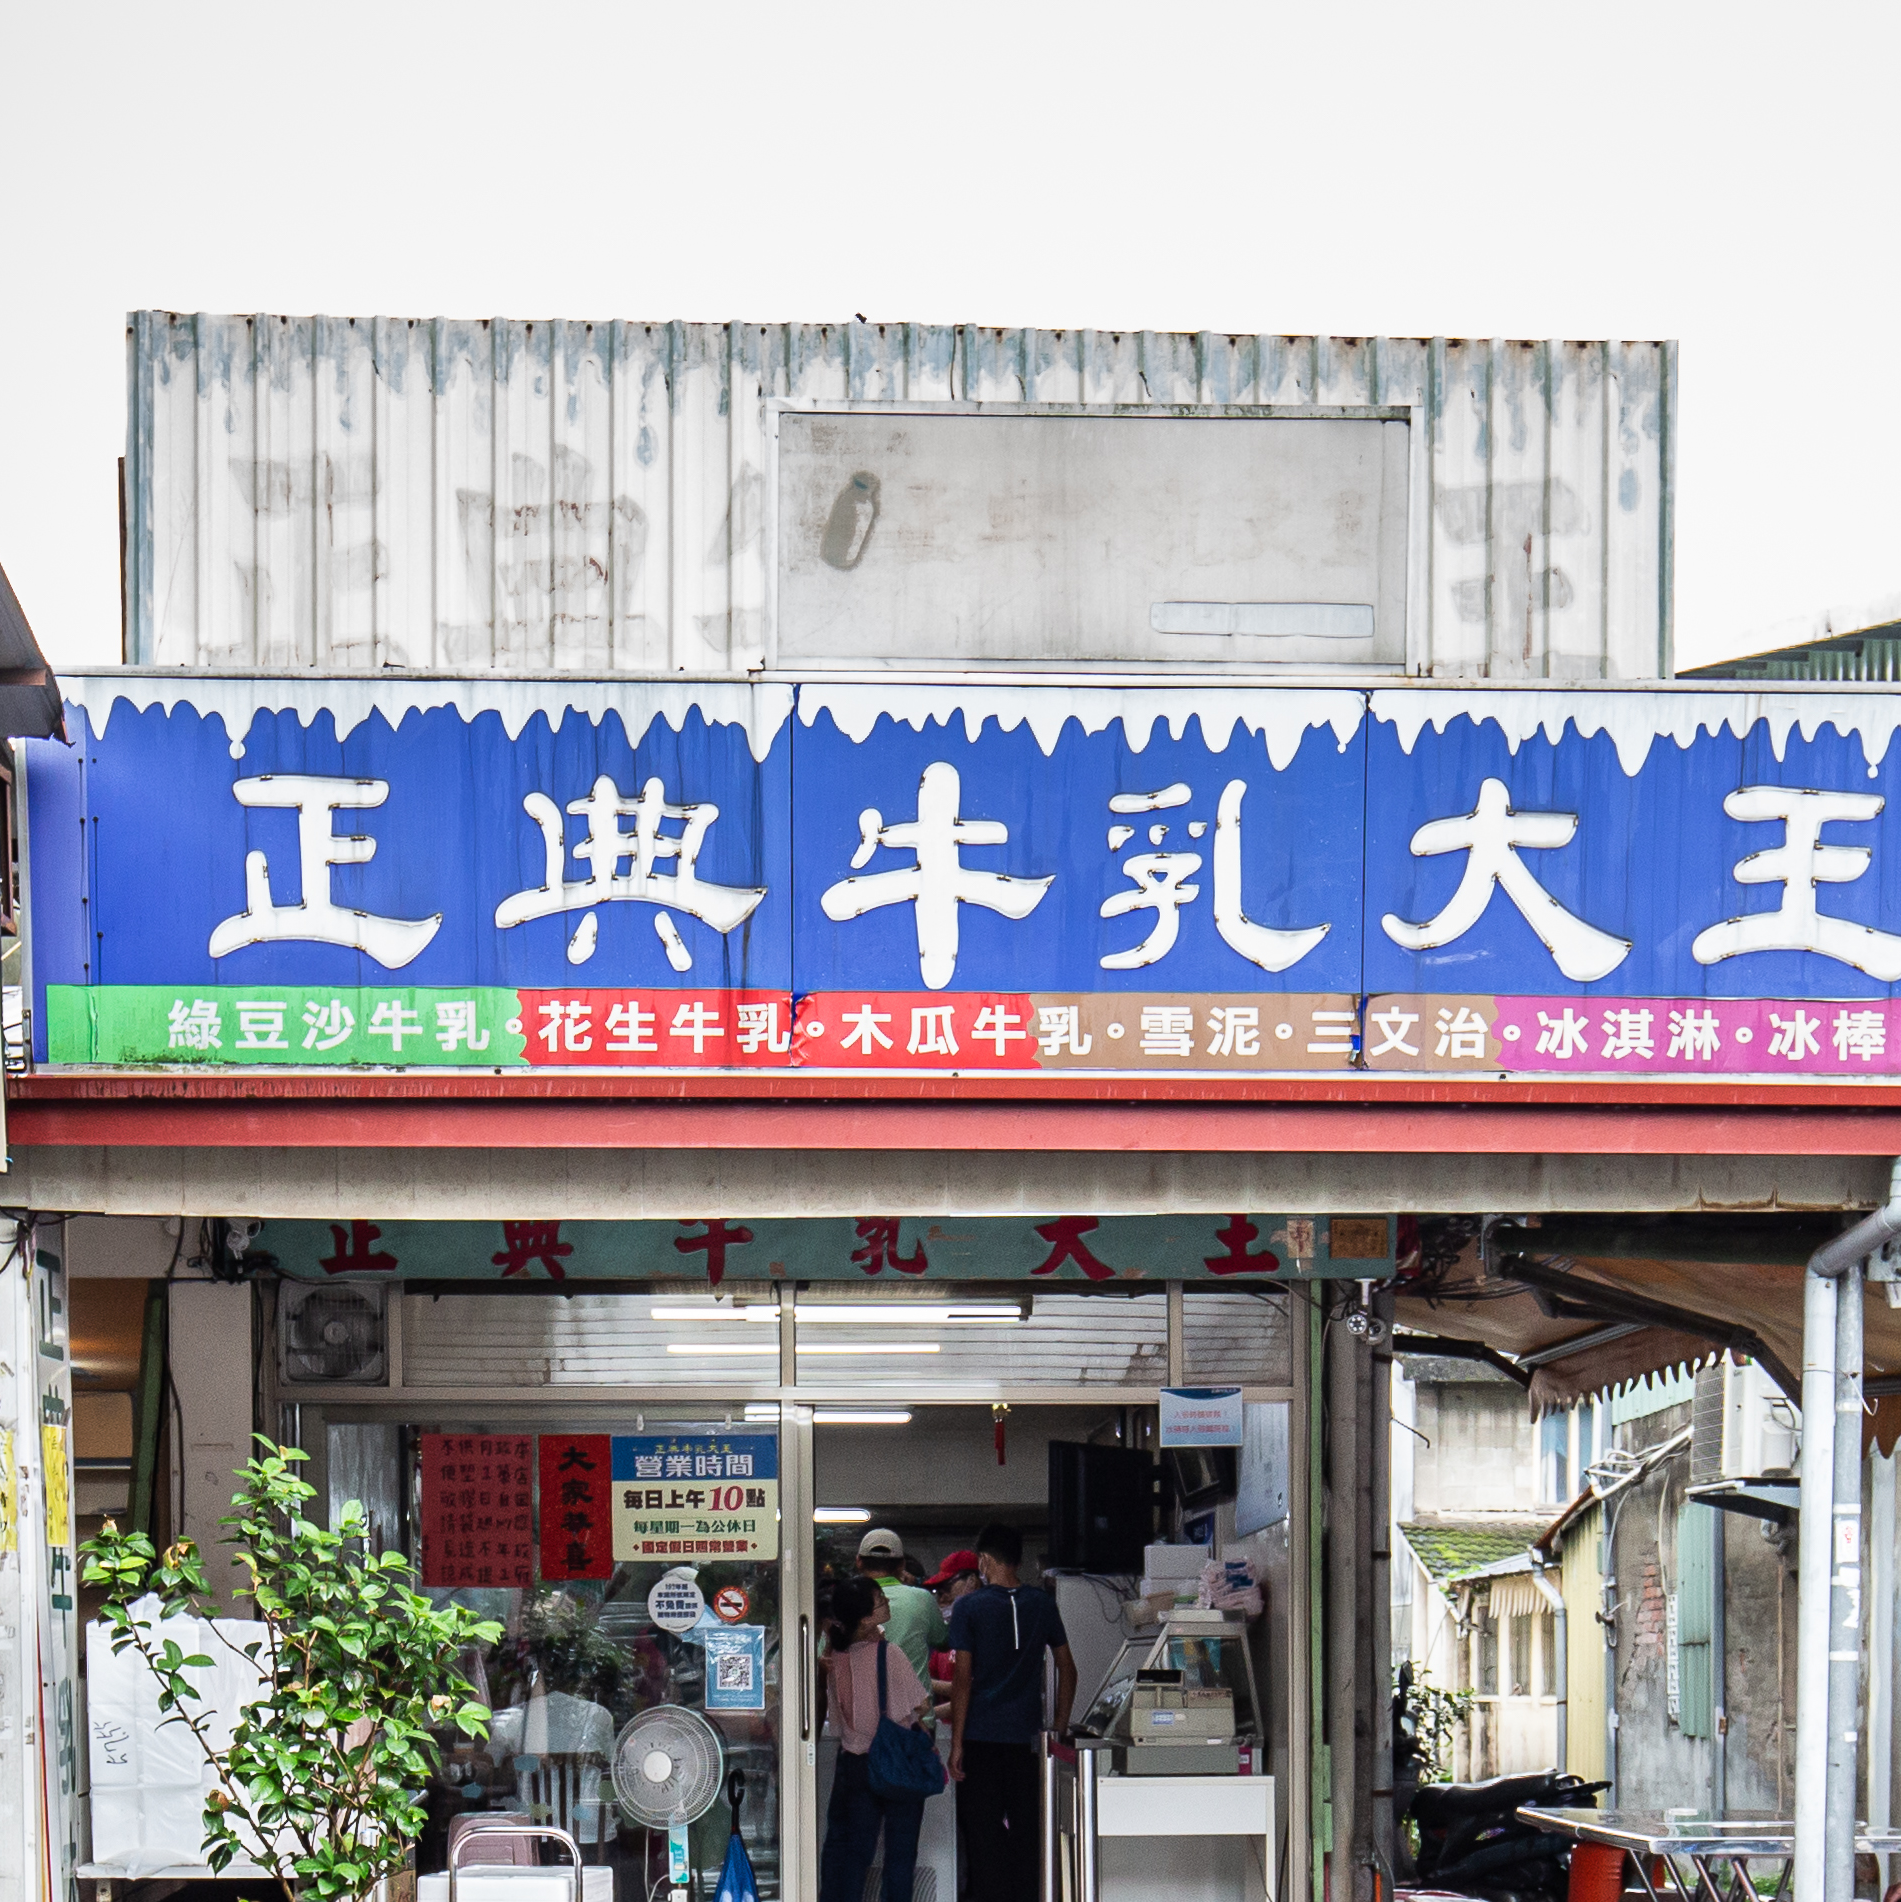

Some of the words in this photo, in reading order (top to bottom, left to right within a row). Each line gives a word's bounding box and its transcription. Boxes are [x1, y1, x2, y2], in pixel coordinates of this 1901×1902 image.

[635, 1455, 754, 1478] 營業時間
[623, 1485, 766, 1511] 每日上午10點
[633, 1520, 756, 1535] 每星期一為公休日
